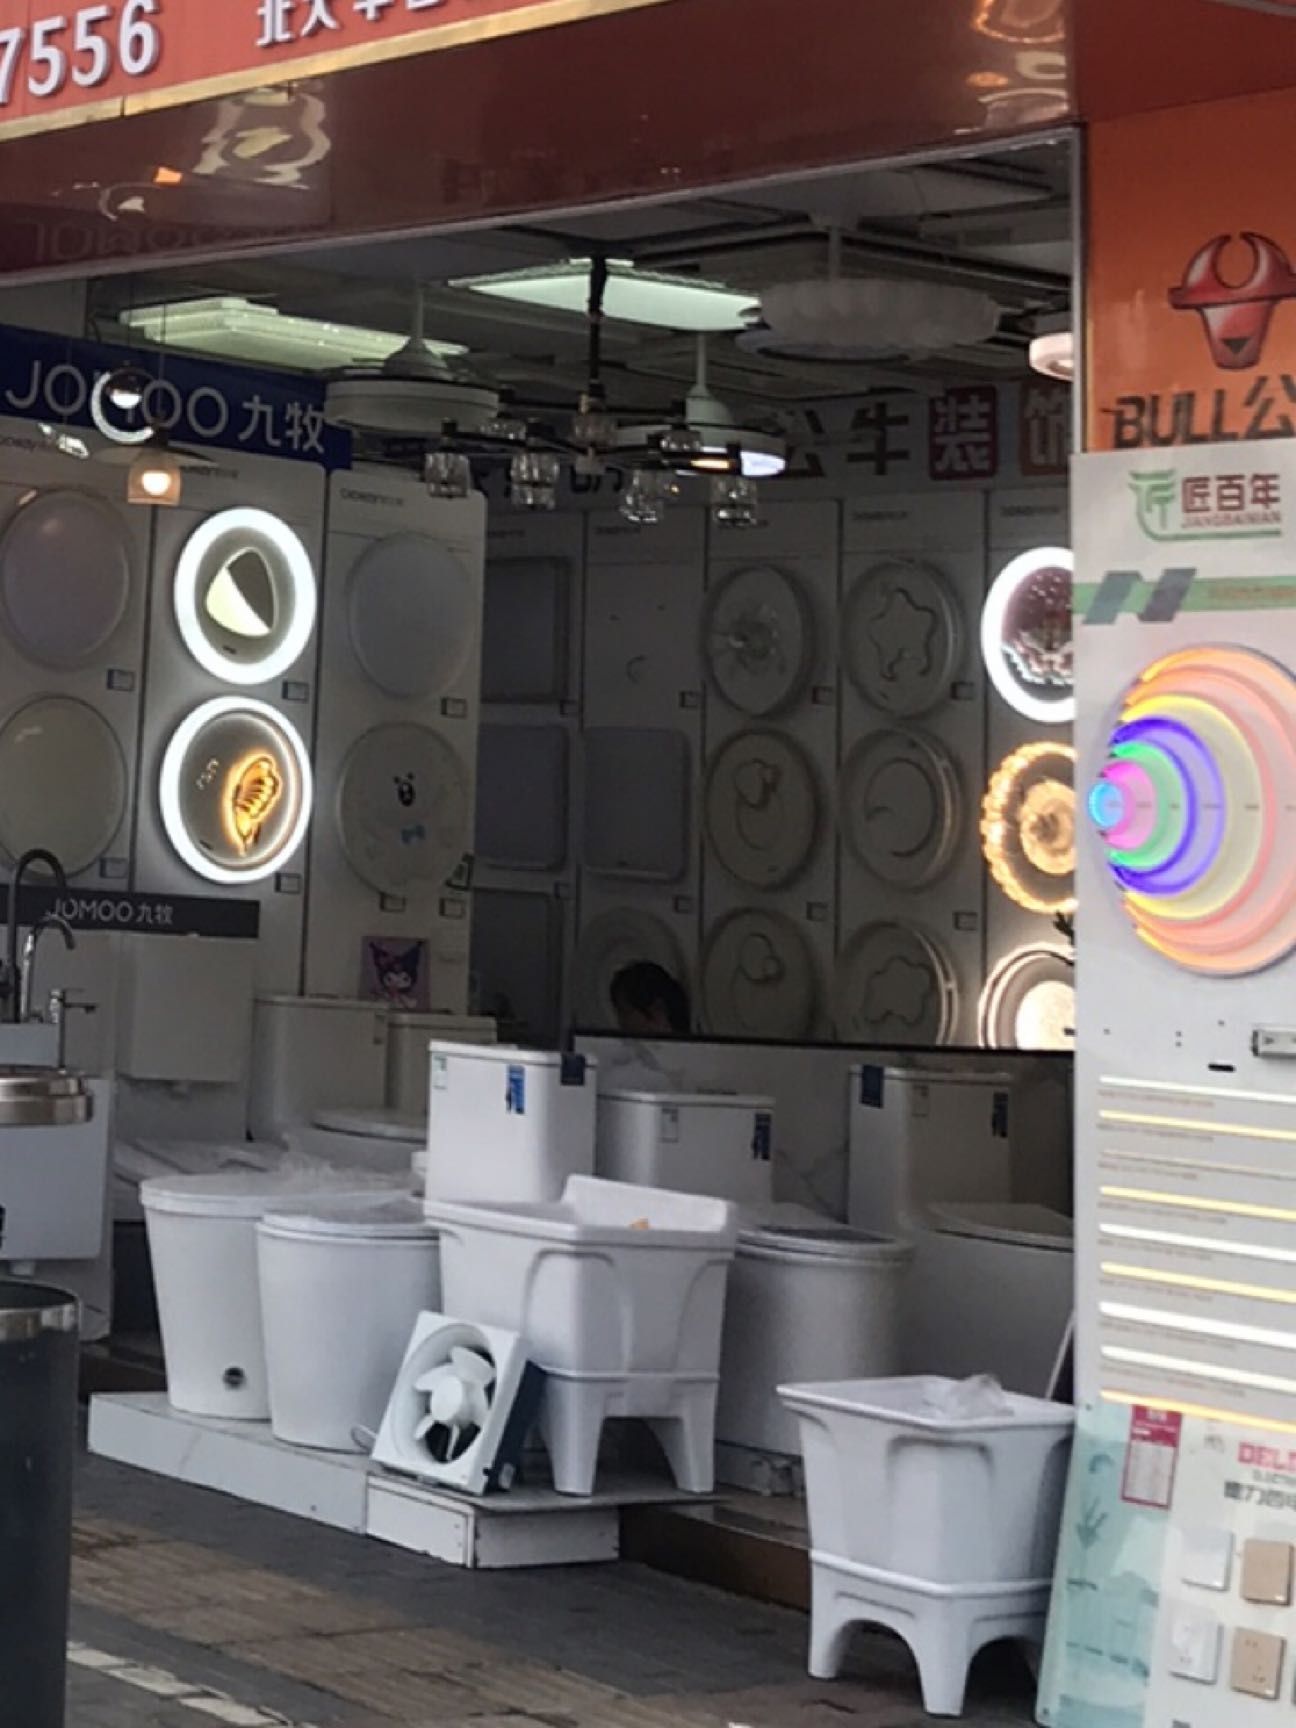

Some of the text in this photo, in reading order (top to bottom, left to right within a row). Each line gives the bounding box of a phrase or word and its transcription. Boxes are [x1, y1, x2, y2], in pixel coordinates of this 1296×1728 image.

[238, 393, 325, 455] 九牧
[1112, 388, 1240, 449] BULL
[1181, 473, 1281, 514] 匠百年
